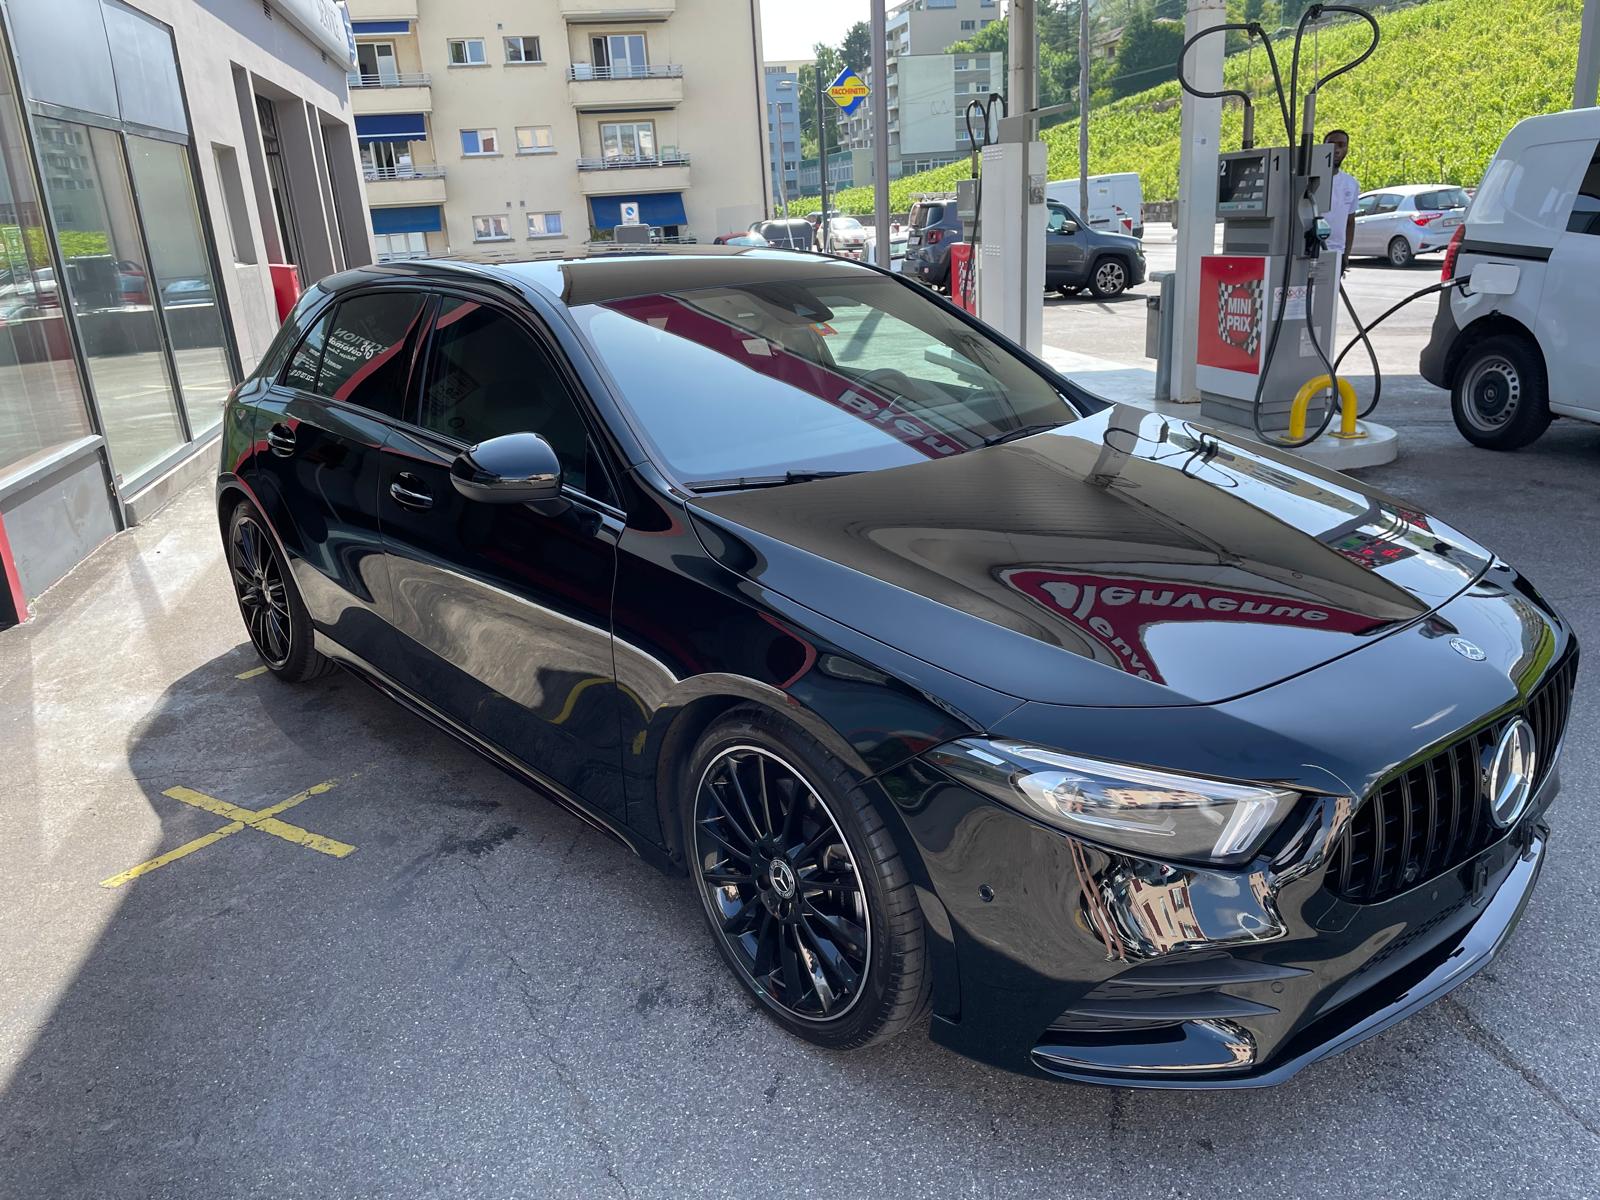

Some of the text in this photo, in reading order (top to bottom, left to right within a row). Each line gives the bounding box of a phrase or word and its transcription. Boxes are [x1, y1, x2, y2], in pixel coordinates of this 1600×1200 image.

[831, 87, 866, 96] FACCHINETTI
[1219, 160, 1227, 177] 2
[1273, 155, 1280, 172] 1
[1325, 152, 1332, 168] 1
[1227, 297, 1252, 315] MINI
[1226, 314, 1252, 333] PRIX
